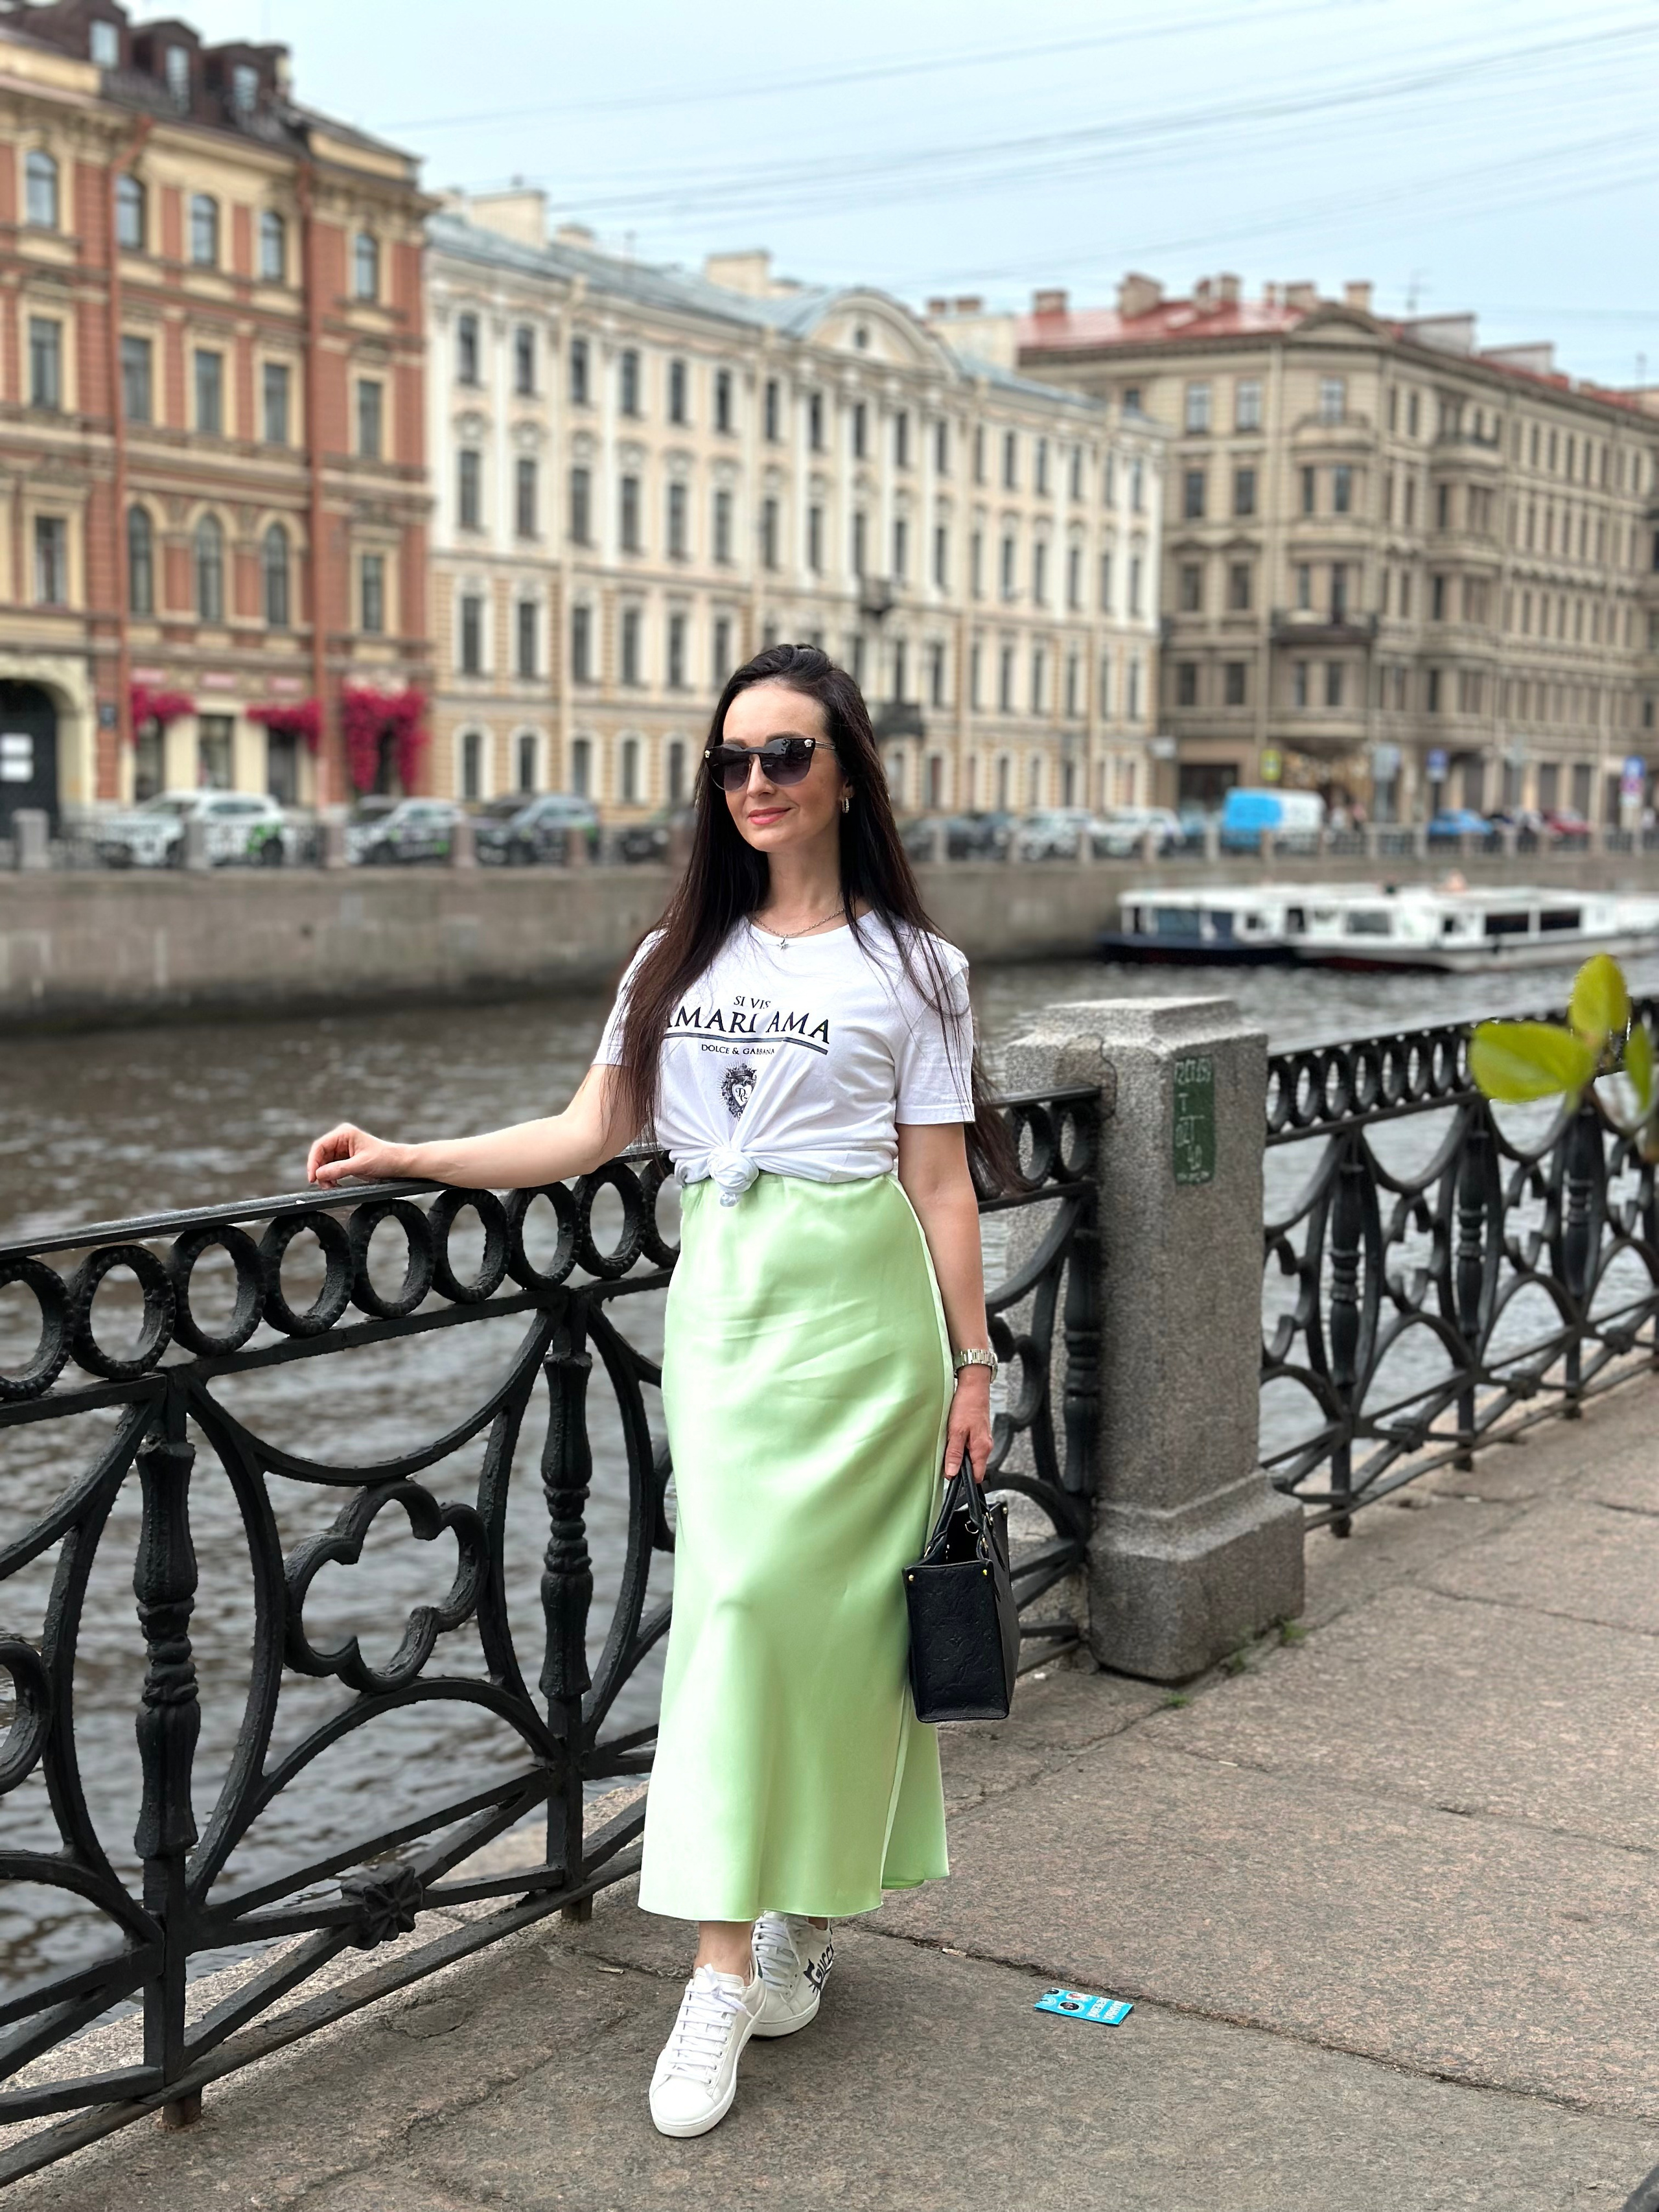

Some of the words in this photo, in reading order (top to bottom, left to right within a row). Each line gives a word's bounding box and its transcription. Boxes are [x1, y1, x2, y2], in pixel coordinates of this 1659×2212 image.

[733, 995, 746, 1007] SI
[750, 997, 771, 1009] VIS
[765, 1010, 830, 1044] AMA
[701, 1044, 730, 1054] DOLCE
